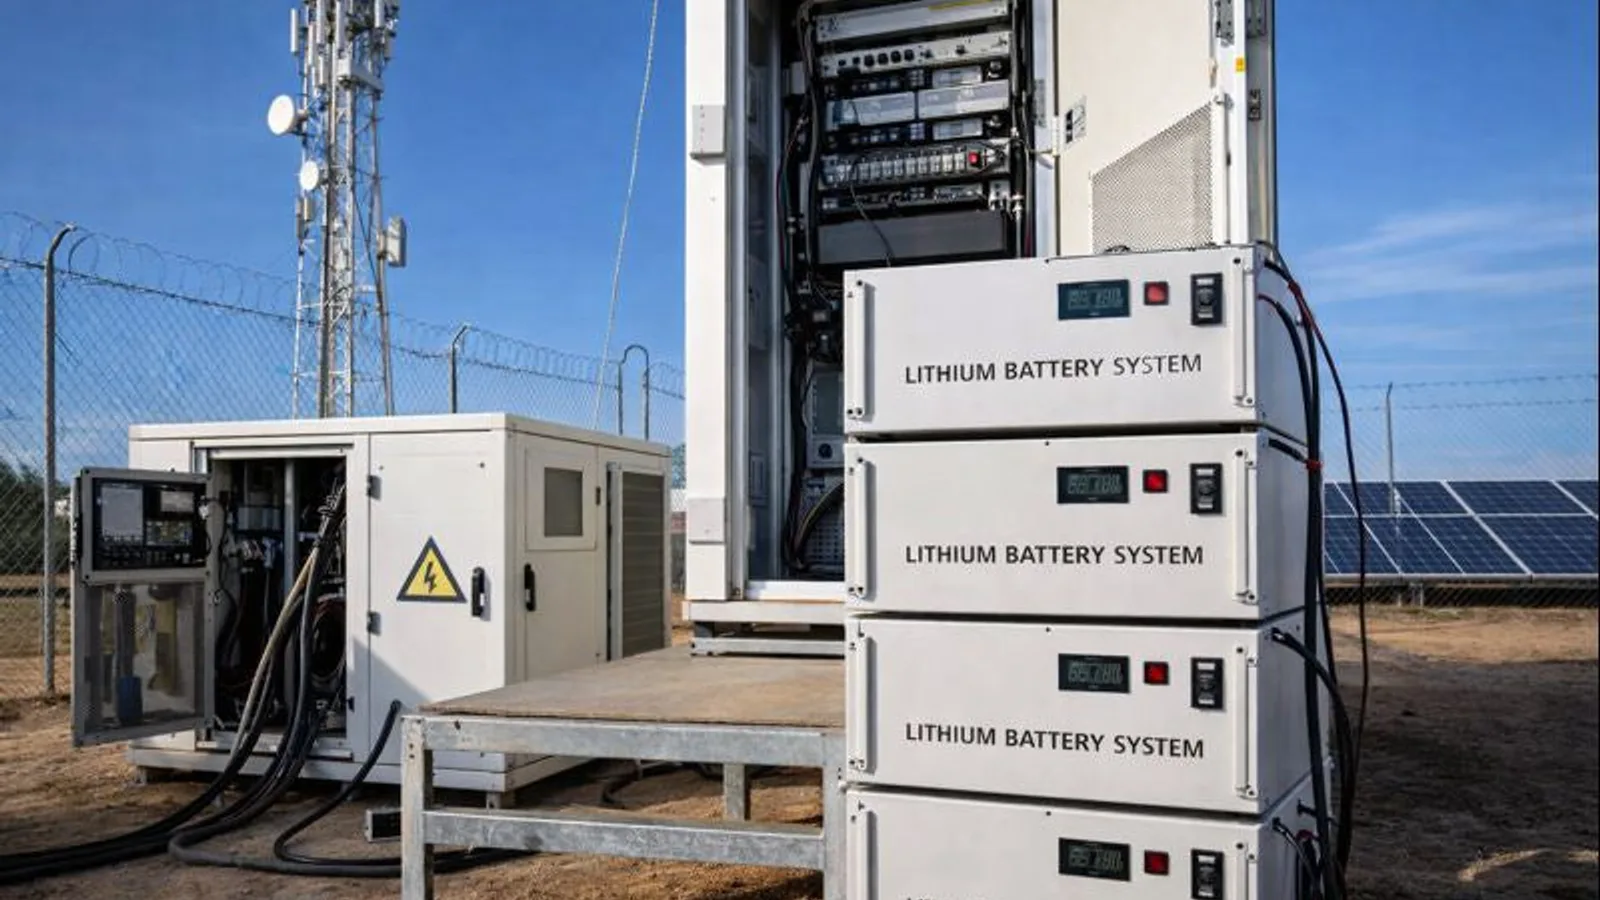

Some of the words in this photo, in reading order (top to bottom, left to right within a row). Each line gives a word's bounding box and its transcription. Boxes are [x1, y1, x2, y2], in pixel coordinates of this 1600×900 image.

[905, 363, 996, 384] LITHIUM
[1005, 358, 1104, 380] BATTERY
[1113, 353, 1203, 377] SYSTEM
[905, 545, 997, 565] LITHIUM
[1005, 545, 1105, 565] BATTERY
[1114, 545, 1204, 565] SYSTEM
[905, 723, 997, 746] LITHIUM
[1005, 728, 1105, 752] BATTERY
[1113, 734, 1205, 759] SYSTEM
